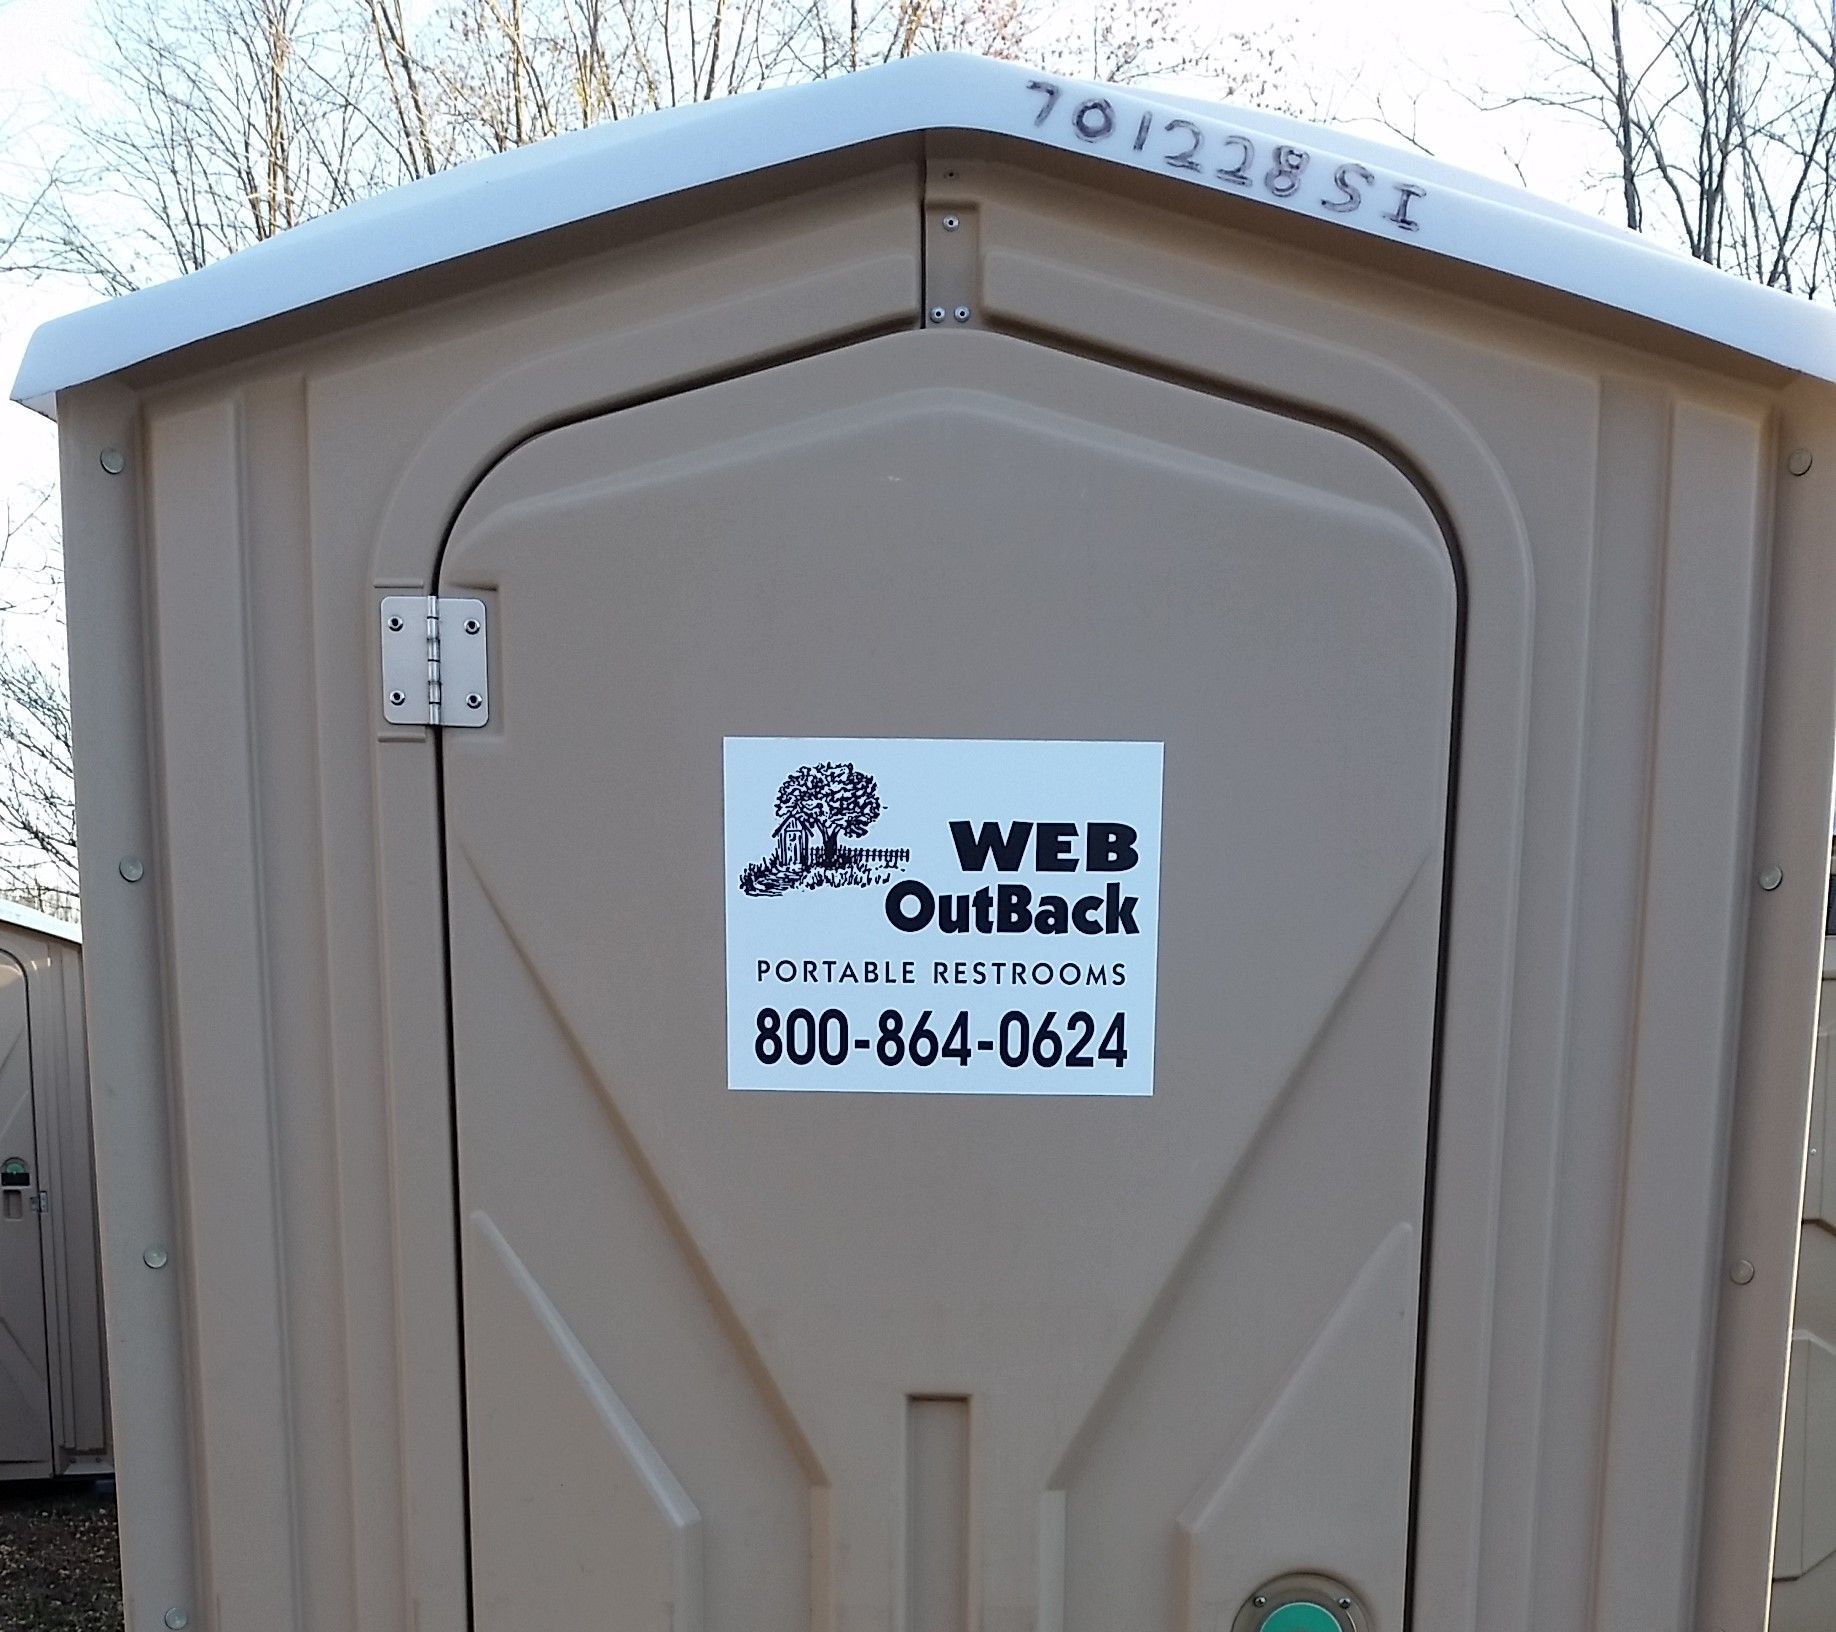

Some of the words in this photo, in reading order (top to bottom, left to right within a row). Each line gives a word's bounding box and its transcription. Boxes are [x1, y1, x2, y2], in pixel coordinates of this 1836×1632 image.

[949, 820, 1139, 873] WEB
[884, 879, 1140, 935] OutBack
[757, 959, 915, 984] PORTABLE
[933, 961, 1126, 986] RESTROOMS
[754, 1007, 1128, 1068] 800-864-0624
